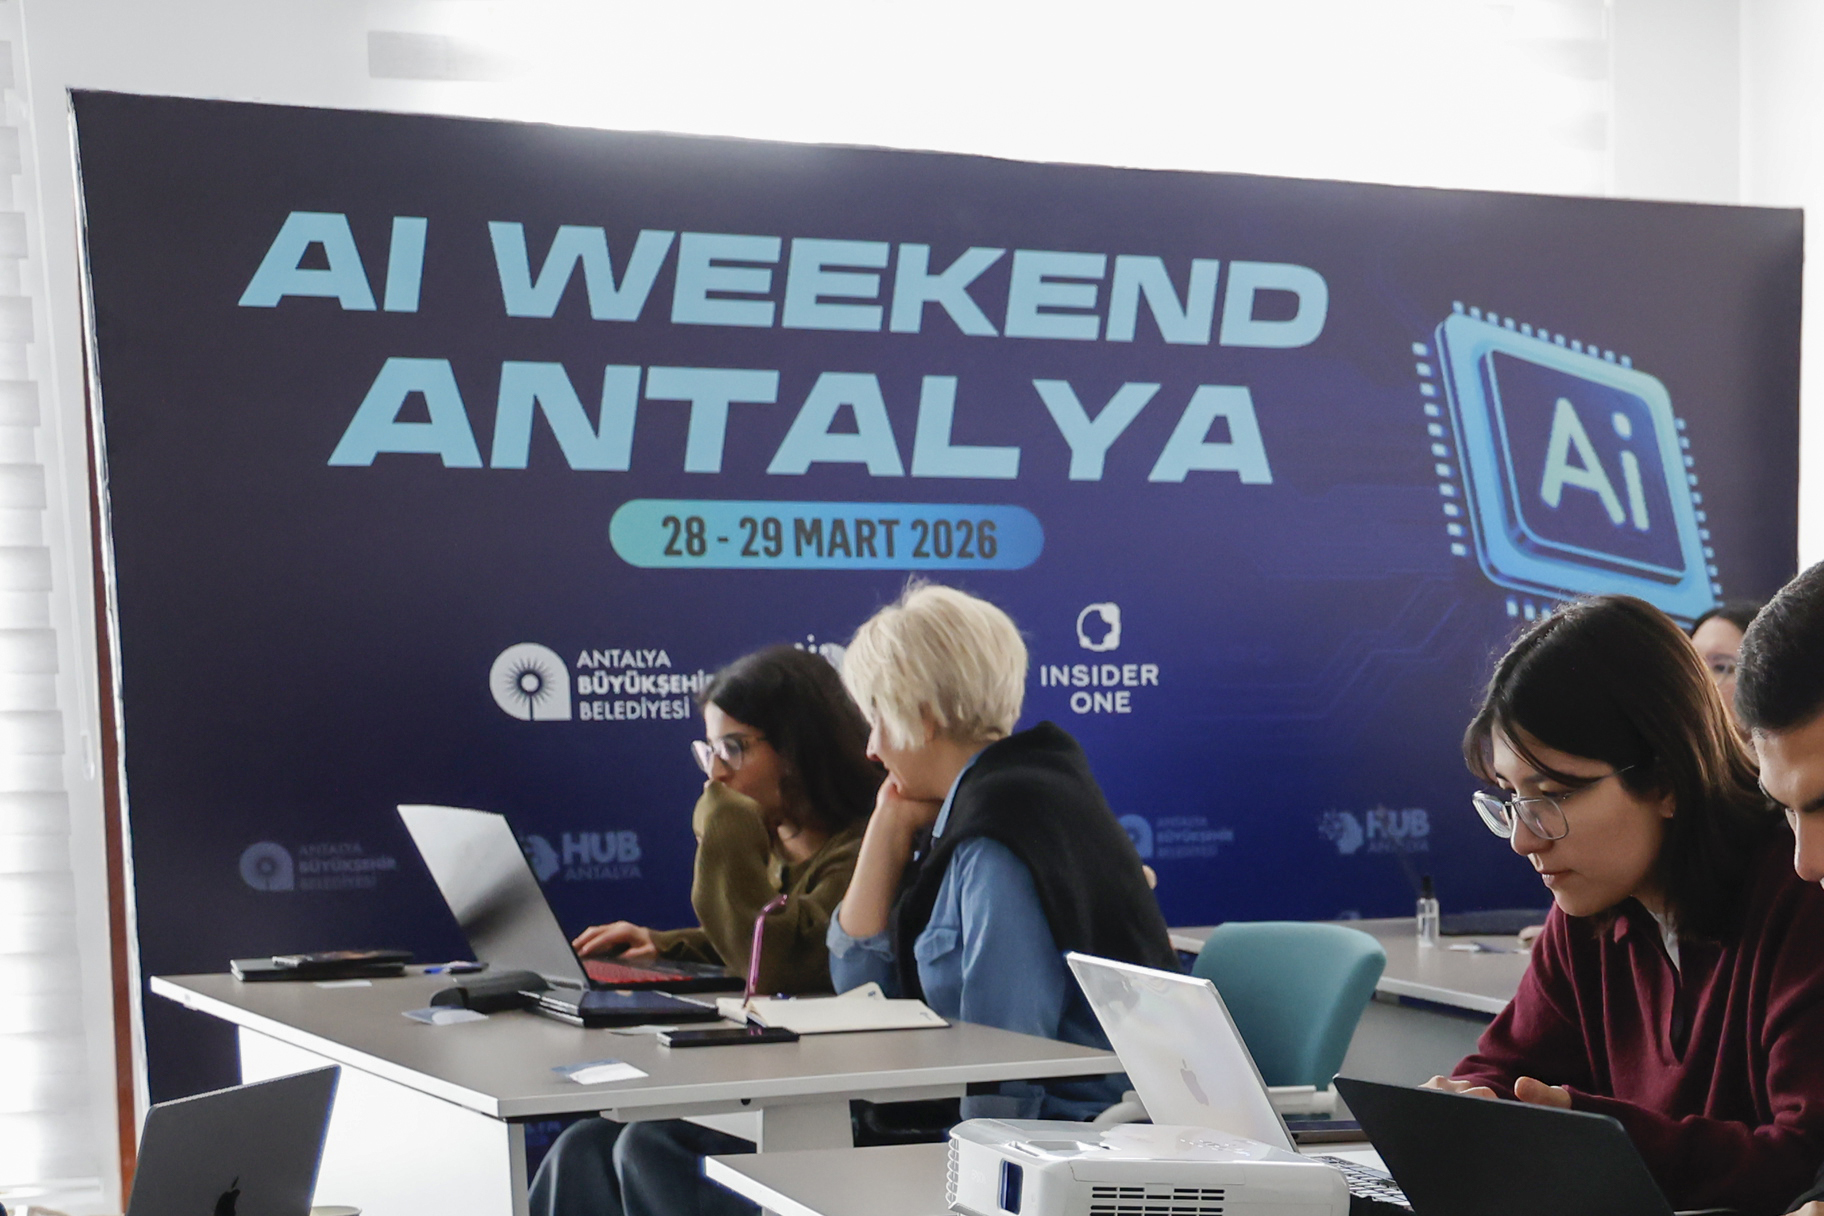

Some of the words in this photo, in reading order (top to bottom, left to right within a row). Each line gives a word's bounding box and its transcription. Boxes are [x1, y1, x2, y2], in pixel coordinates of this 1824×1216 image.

[237, 210, 428, 313] AI
[487, 219, 1330, 349] WEEKEND
[327, 356, 1274, 486] ANTALYA
[1540, 396, 1650, 533] Ai
[662, 515, 707, 557] 28
[738, 516, 784, 558] 29
[793, 517, 900, 559] MART
[910, 518, 998, 560] 2026
[576, 648, 672, 669] ANTALYA
[1040, 663, 1159, 688] INSIDER
[579, 695, 691, 722] BELEDİYESİ
[1069, 690, 1132, 715] ONE
[1366, 808, 1431, 839] HUB
[561, 829, 642, 865] HUB
